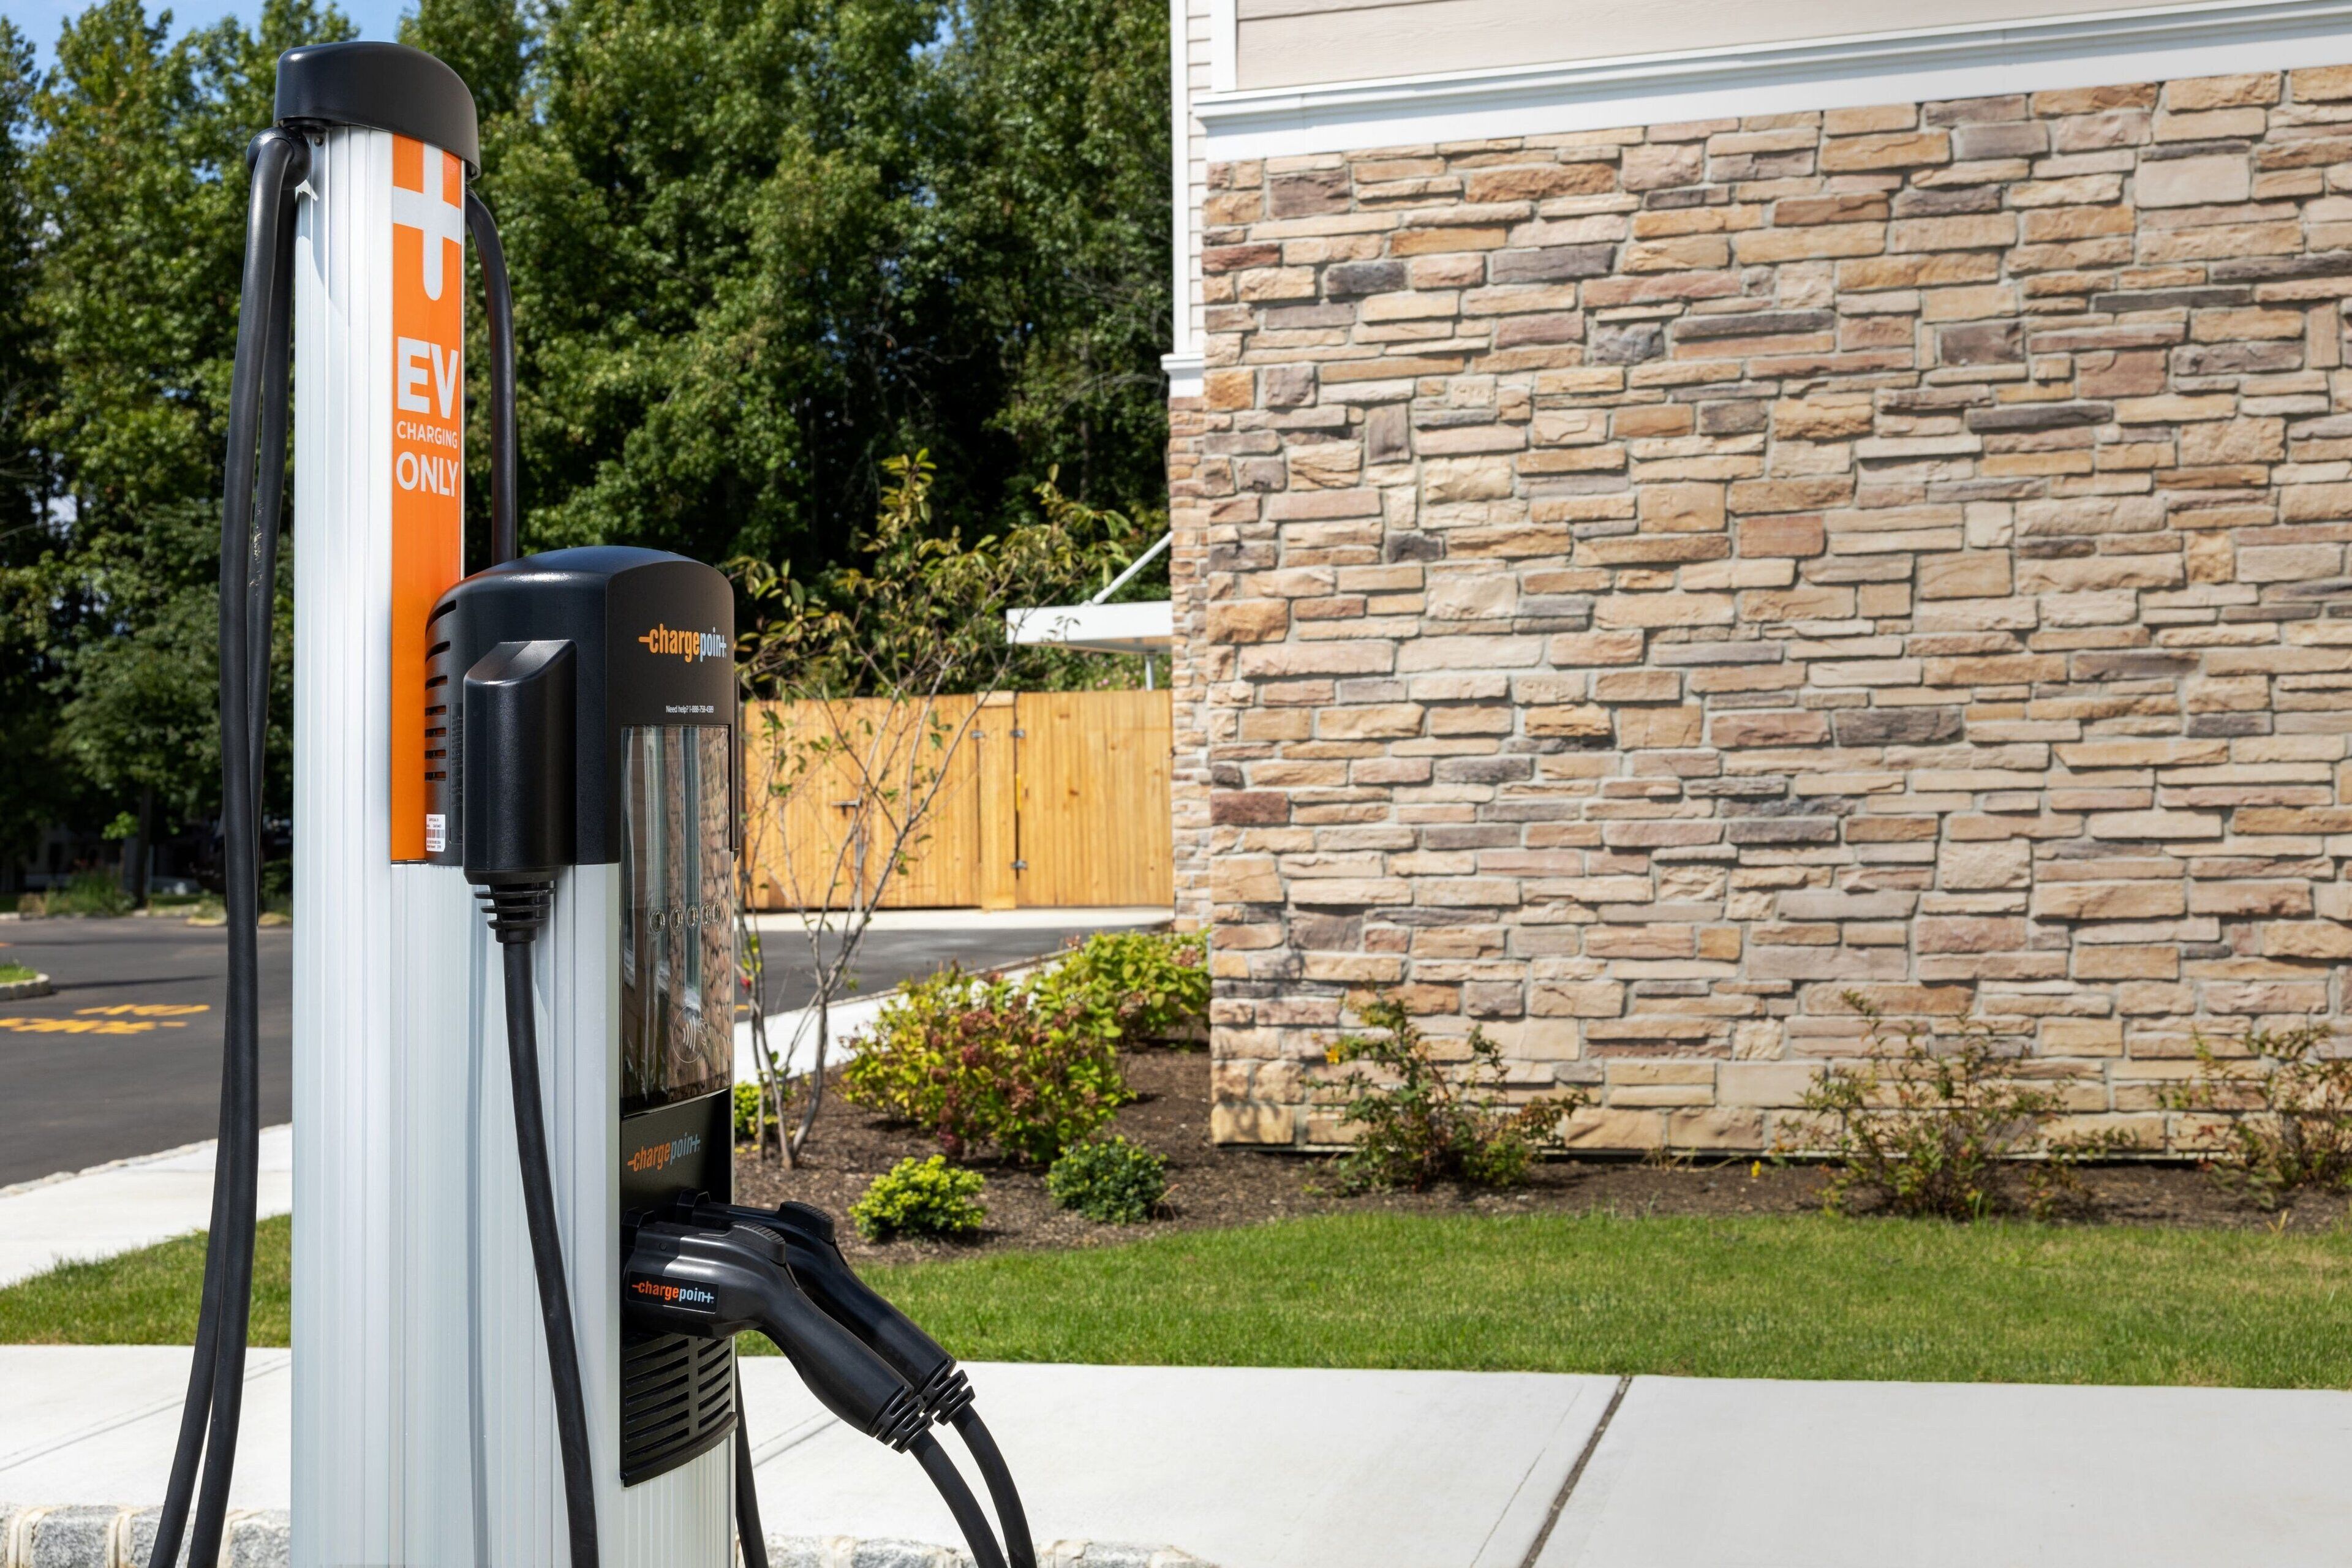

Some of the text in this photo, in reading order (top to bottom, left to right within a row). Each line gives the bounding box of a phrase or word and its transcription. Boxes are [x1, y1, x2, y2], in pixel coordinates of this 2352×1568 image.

[398, 336, 459, 419] EV
[397, 420, 458, 449] CHARGING
[396, 451, 459, 497] ONLY
[678, 705, 688, 714] help?
